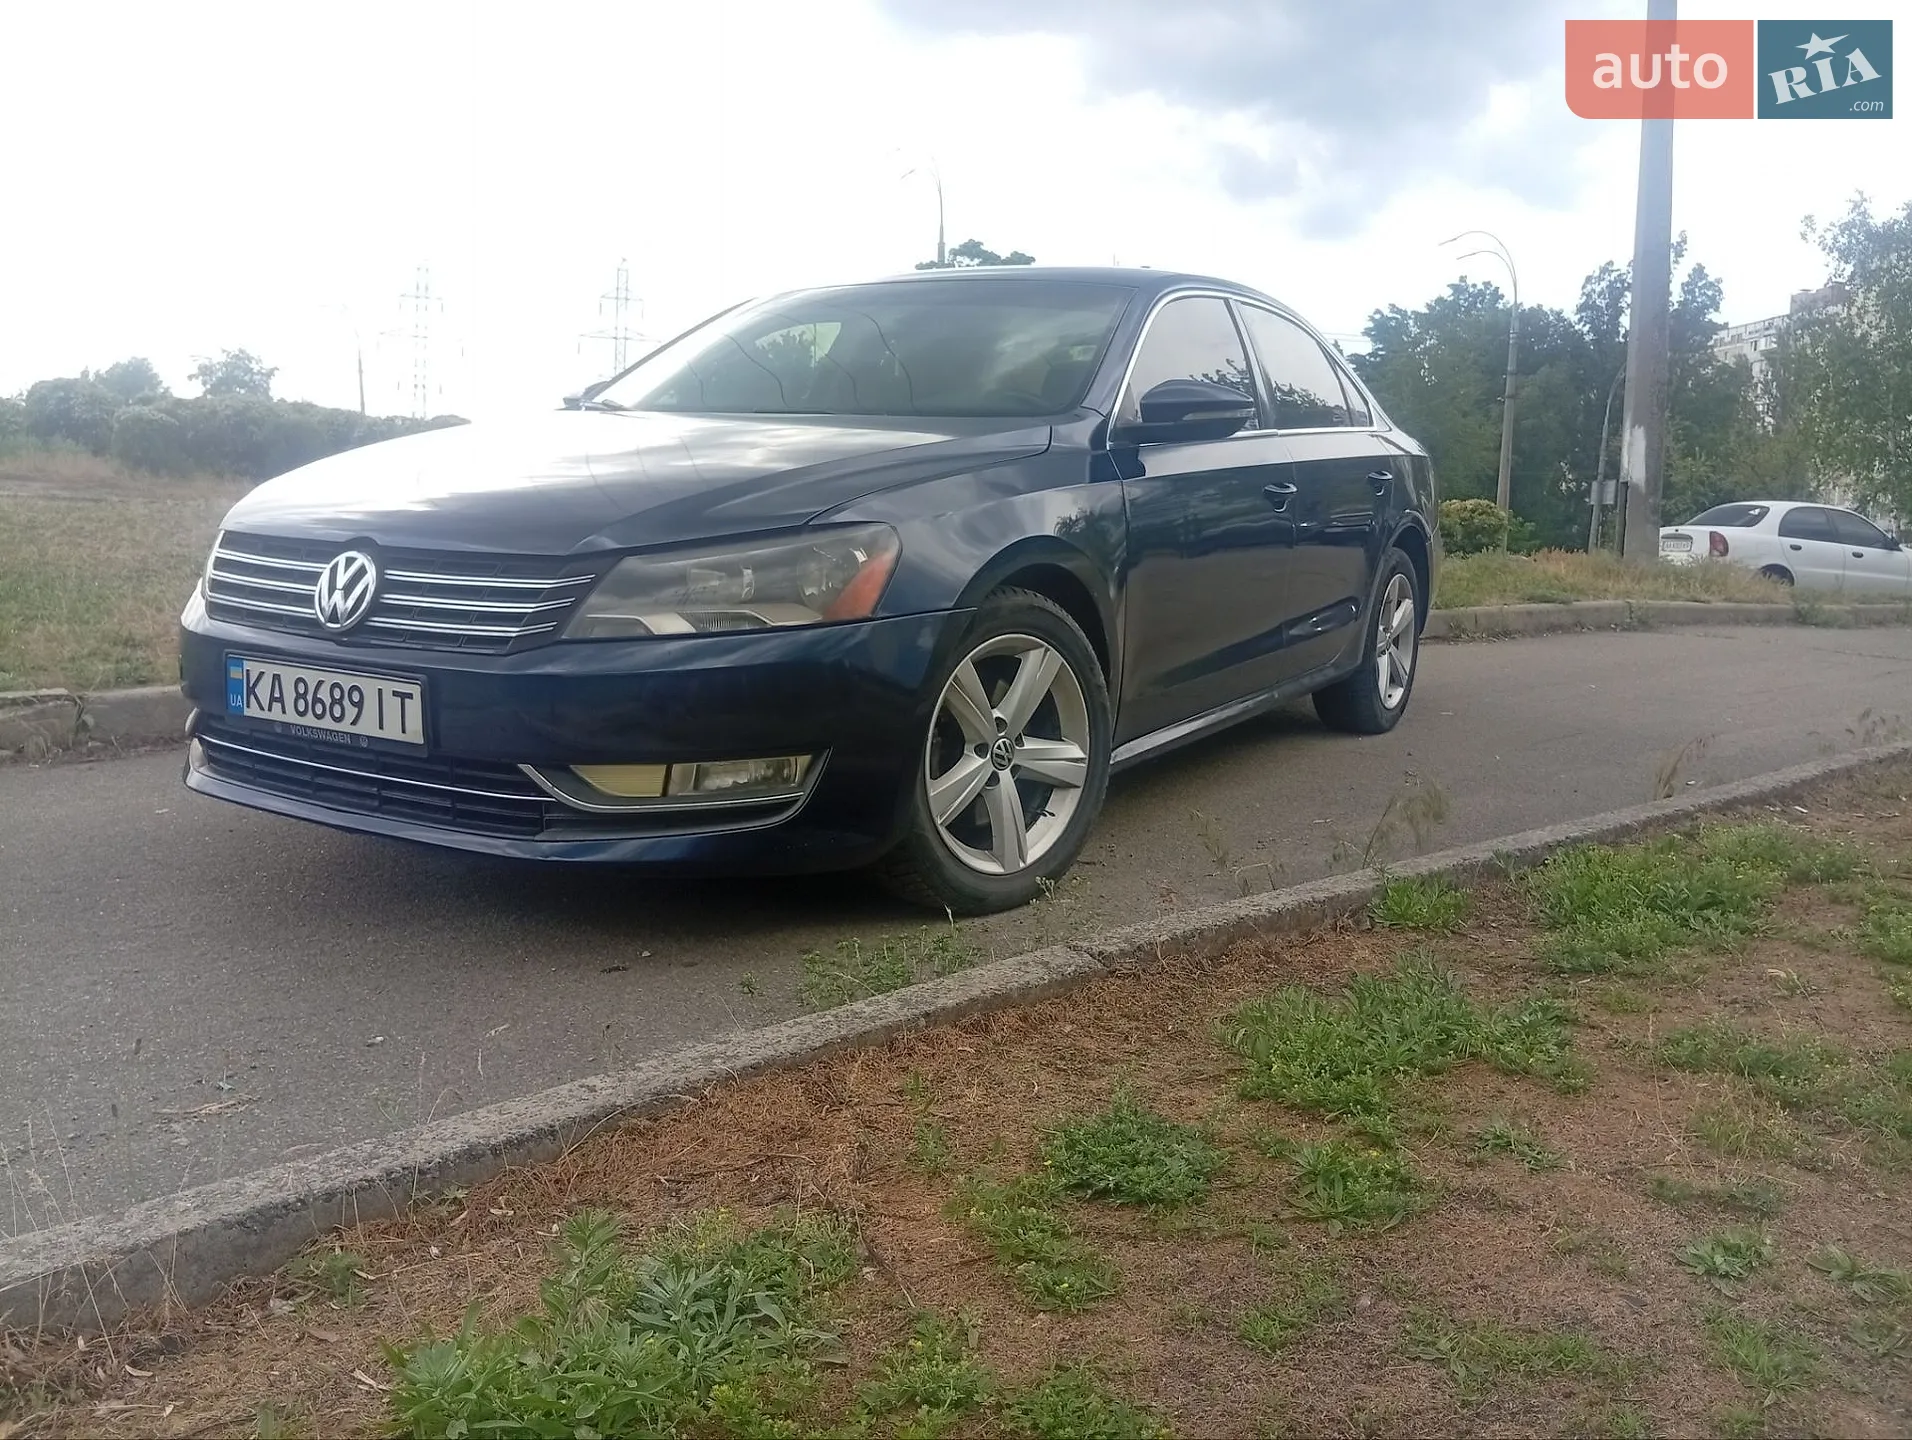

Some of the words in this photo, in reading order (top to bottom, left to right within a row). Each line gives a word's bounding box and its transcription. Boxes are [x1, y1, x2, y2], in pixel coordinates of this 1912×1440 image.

[229, 693, 243, 709] UA
[245, 668, 287, 715] KA
[293, 676, 365, 727] 8689
[377, 687, 414, 735] IT
[289, 724, 352, 744] VOLKSWAGEN
